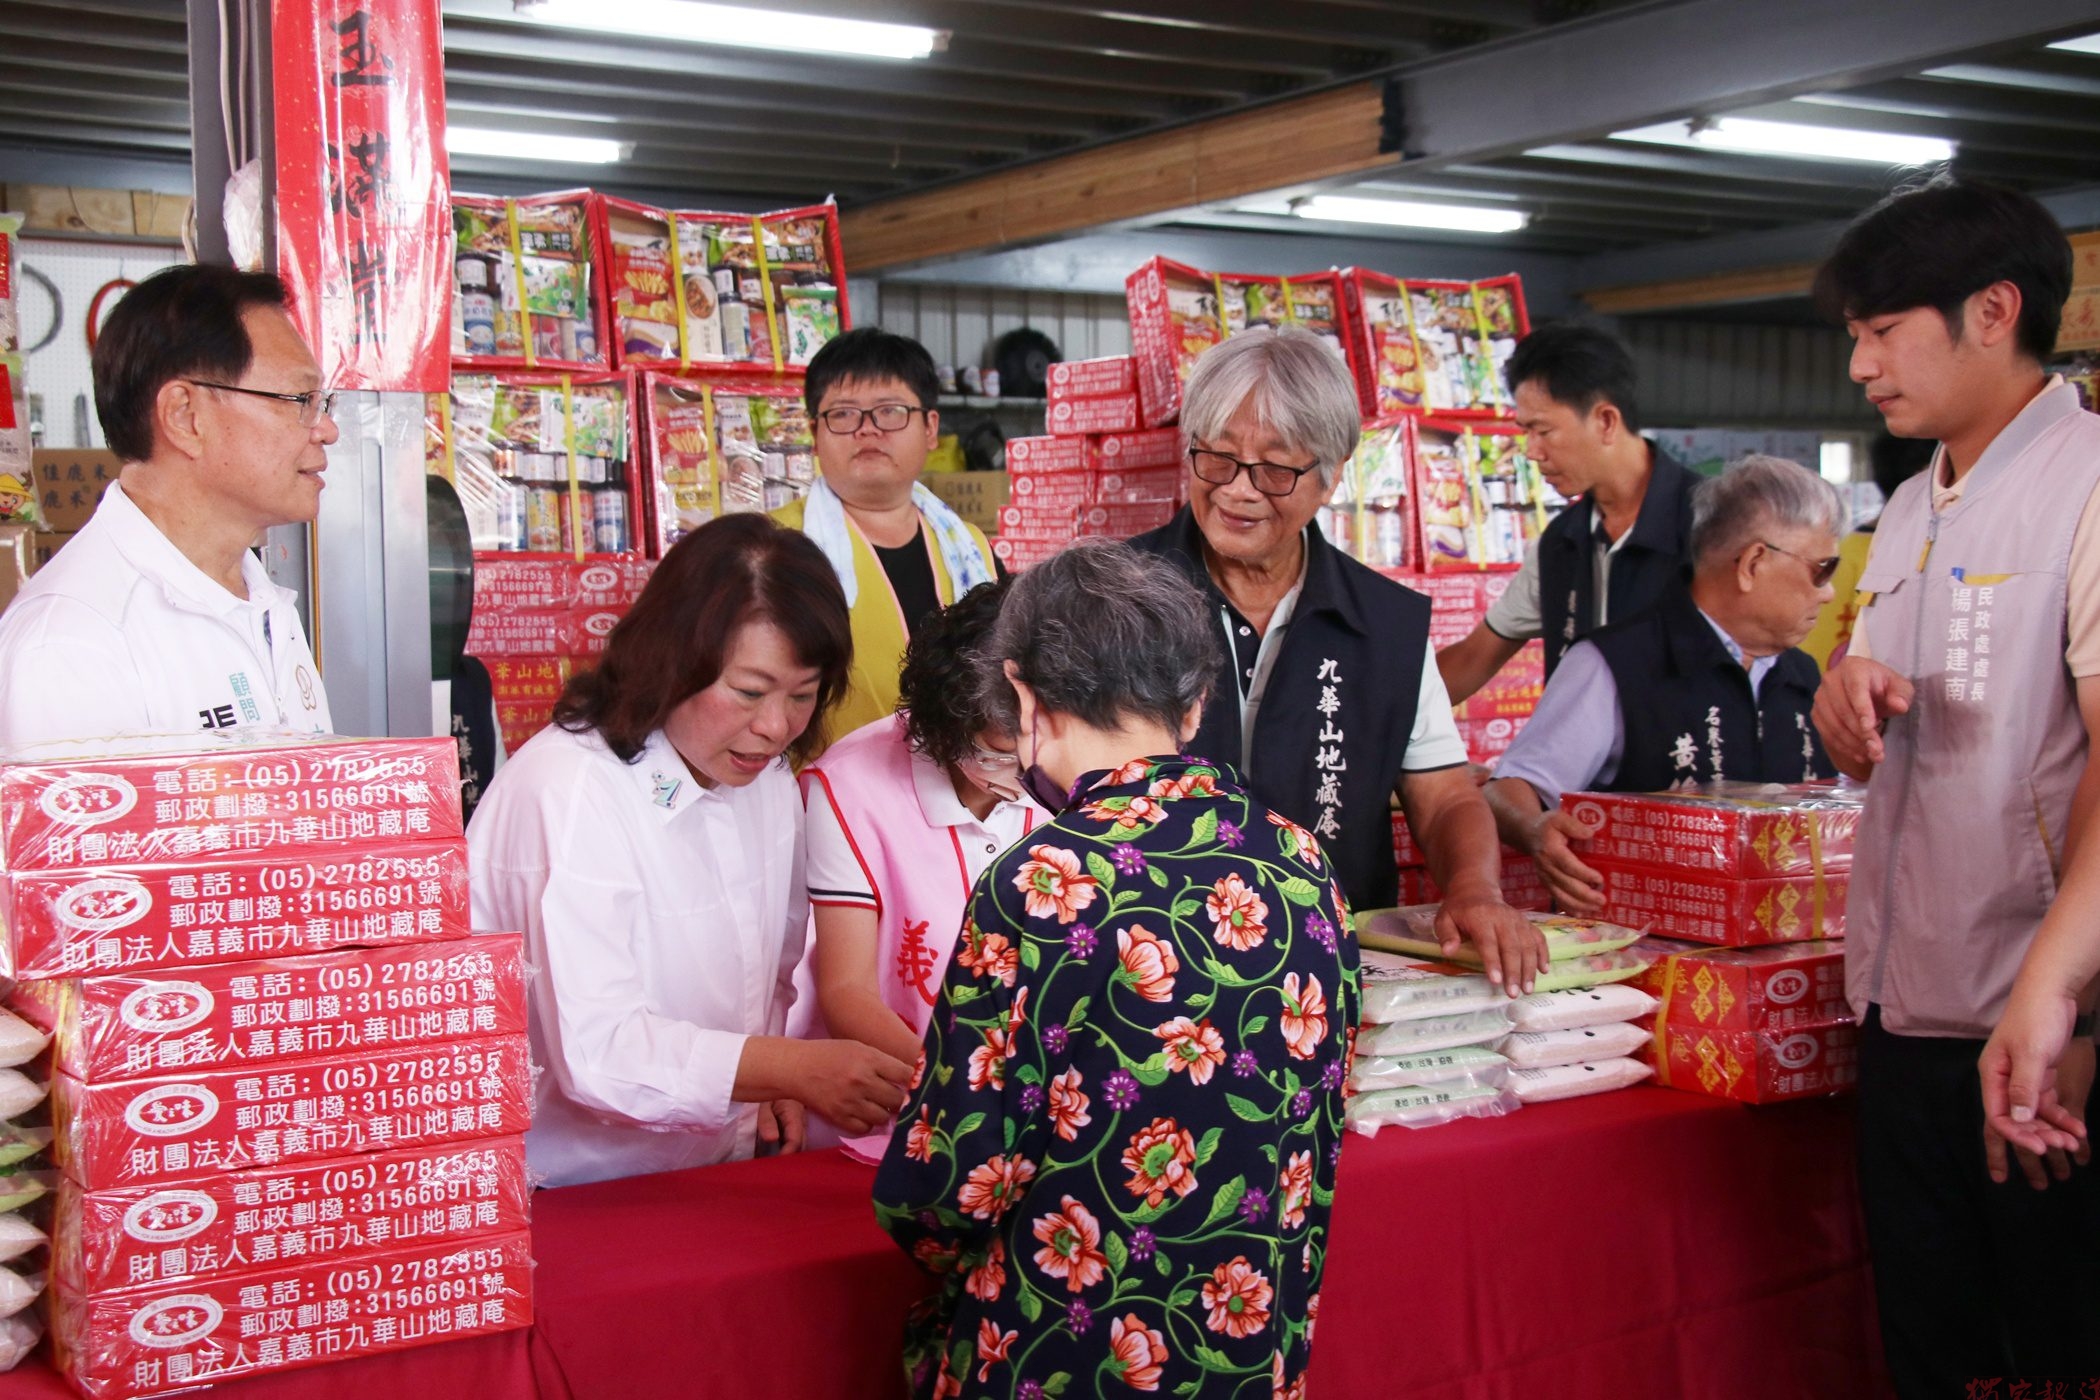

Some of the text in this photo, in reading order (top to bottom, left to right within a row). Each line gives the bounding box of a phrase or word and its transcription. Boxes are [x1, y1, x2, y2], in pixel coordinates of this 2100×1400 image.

[1944, 587, 1973, 702] 楊張建南
[1970, 586, 1995, 702] 民政處處長
[1313, 657, 1348, 840] 九華山地藏庵
[63, 909, 444, 968] 財團法人嘉義市九華山地藏庵
[169, 881, 443, 928] 郵政劃撥:31566691號
[231, 978, 497, 1028] 郵政劃撥:31566691號
[235, 1074, 503, 1130] 郵政劃撥:31566691號
[130, 1102, 503, 1176] 財團法人嘉義市九華山地藏庵
[234, 1174, 499, 1235] 郵政劃撥:31566691號
[128, 1201, 500, 1282] 財團法人嘉義市九華山地藏庵
[240, 1271, 506, 1337] 郵政劃撥:31566691號
[134, 1299, 506, 1389] 財團法人嘉義市九華山地藏庵
